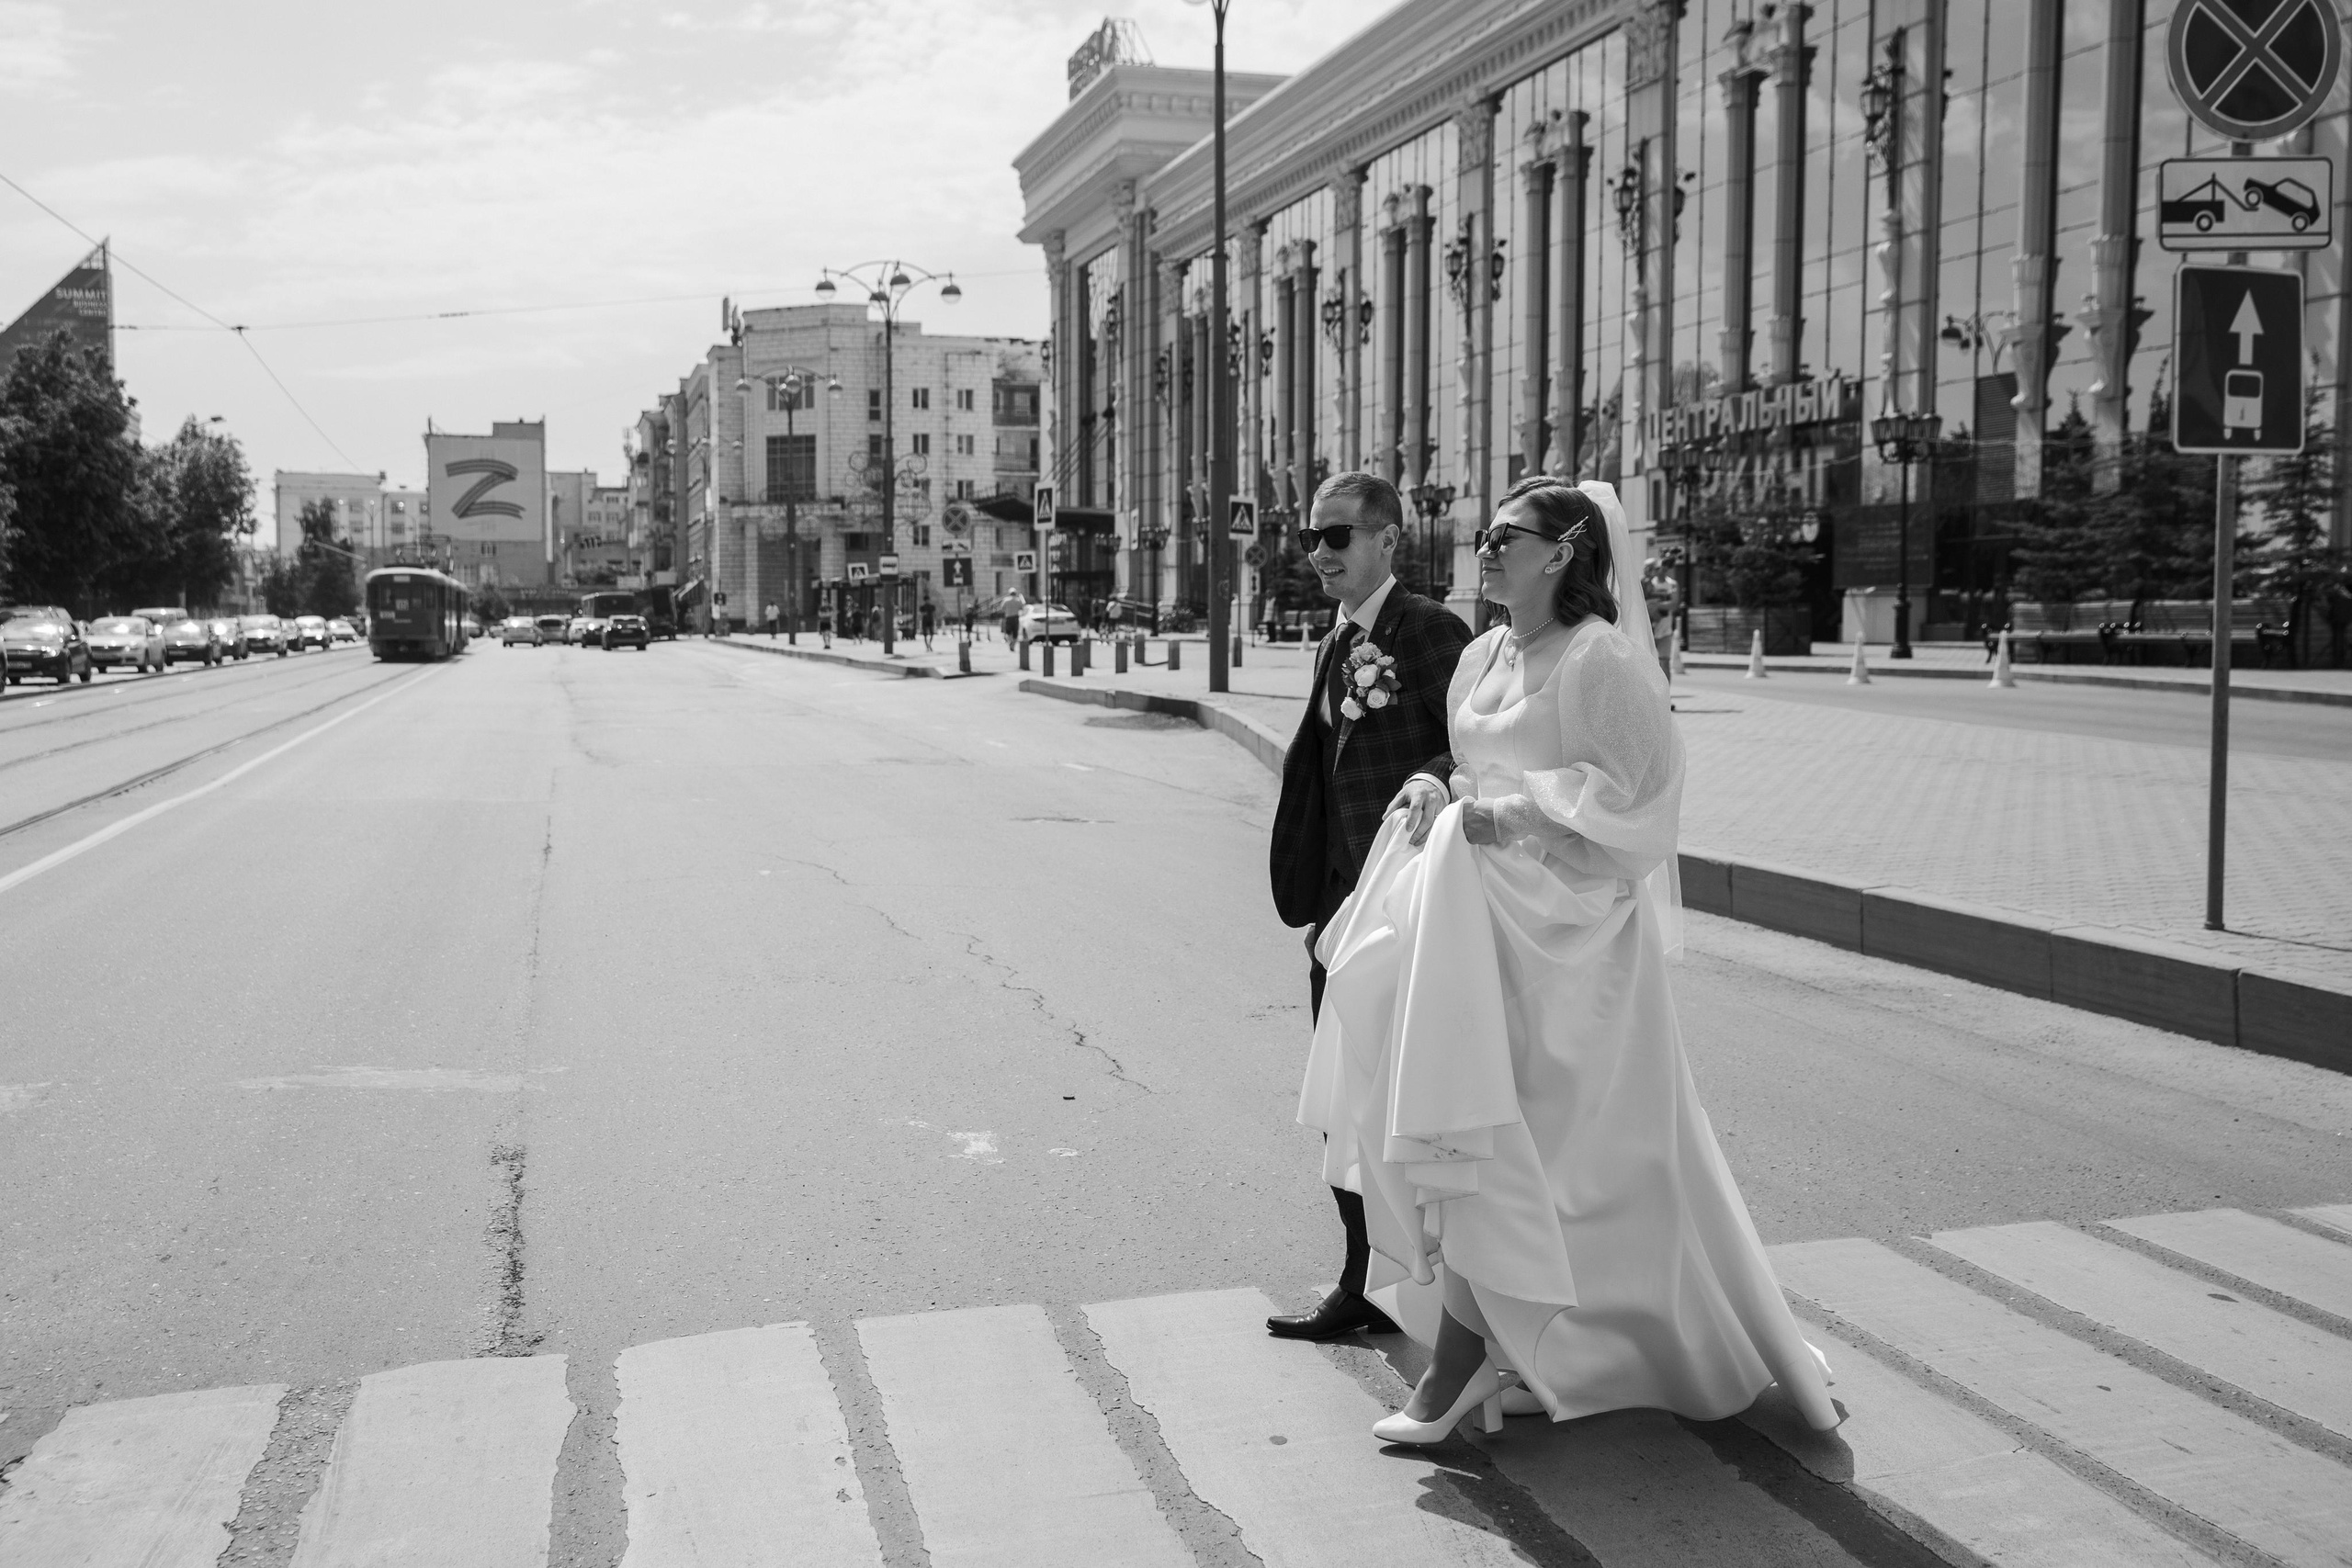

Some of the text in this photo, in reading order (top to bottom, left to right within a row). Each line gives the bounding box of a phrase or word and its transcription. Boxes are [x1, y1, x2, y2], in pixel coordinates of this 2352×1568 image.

[55, 287, 107, 300] SUMMIT
[1645, 370, 1841, 445] ЦЕНТРАЛЬНЫЙ
[445, 458, 526, 519] Z
